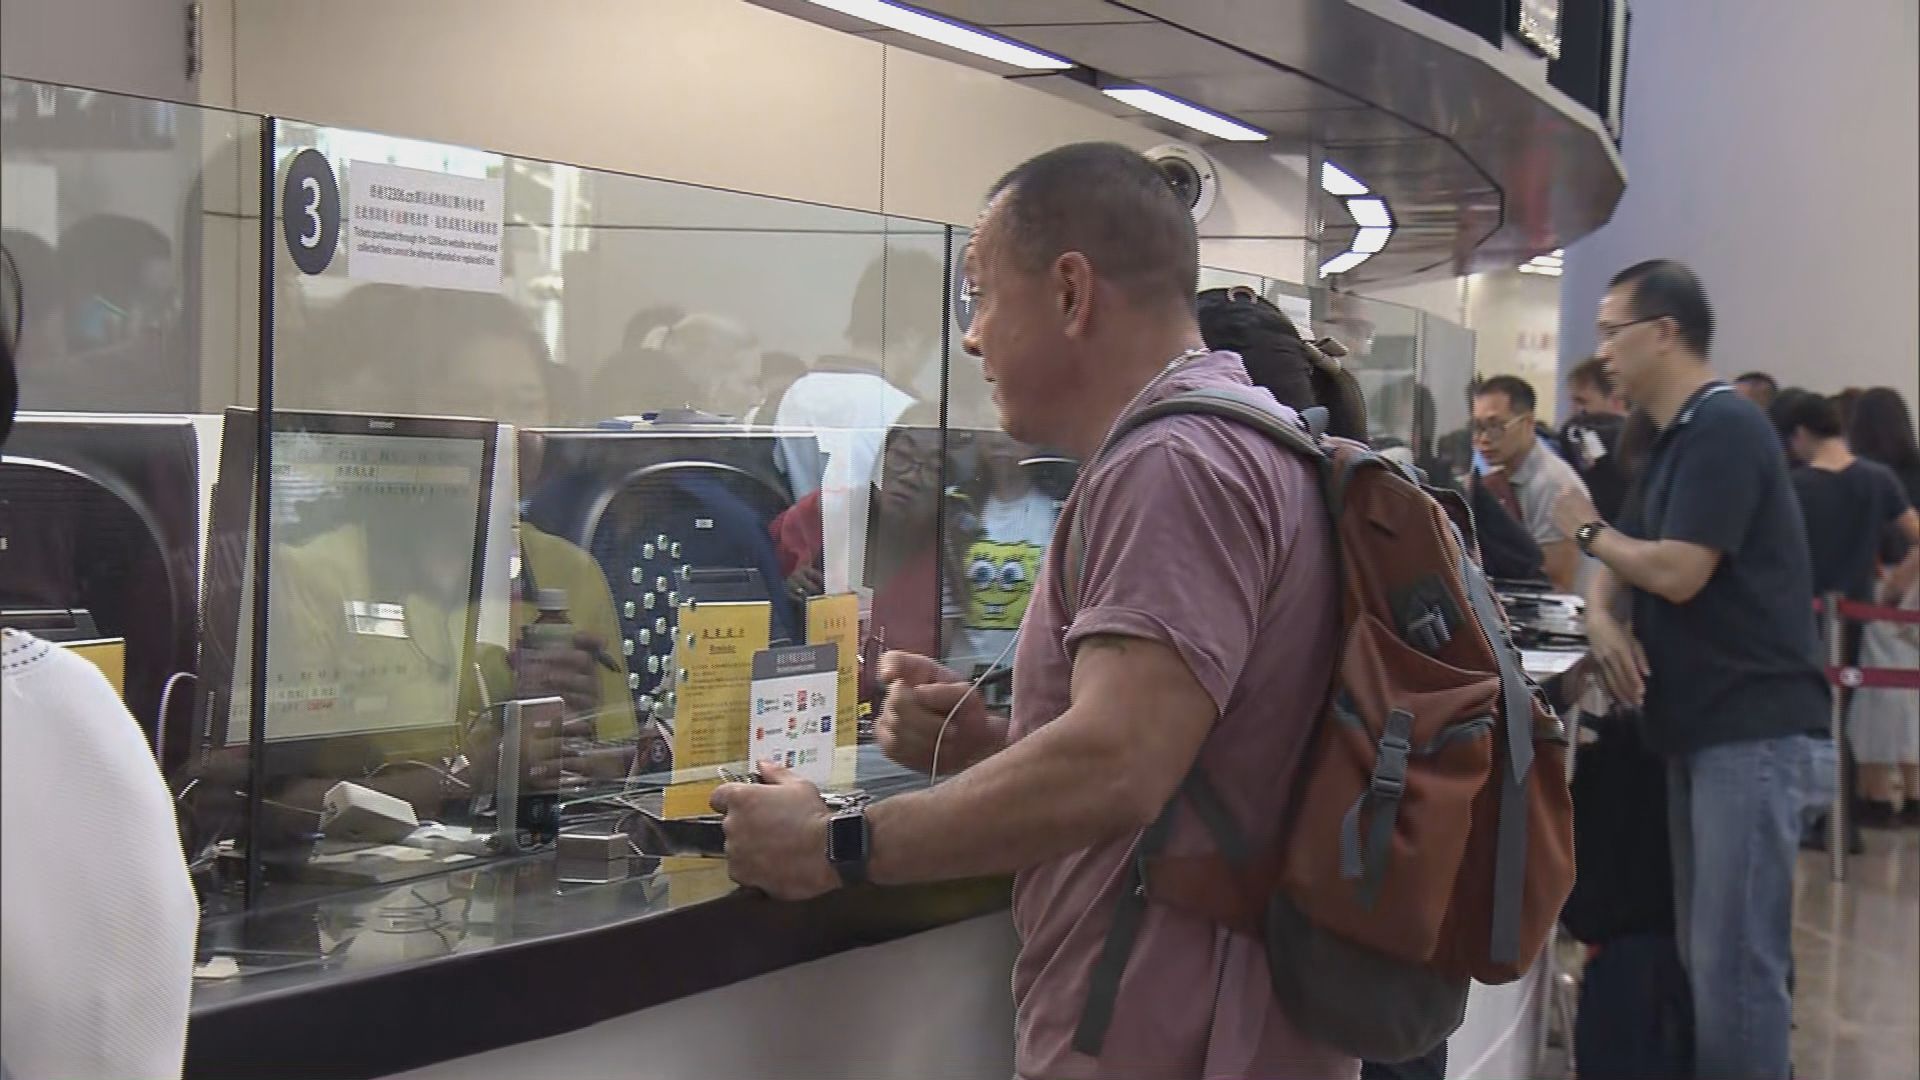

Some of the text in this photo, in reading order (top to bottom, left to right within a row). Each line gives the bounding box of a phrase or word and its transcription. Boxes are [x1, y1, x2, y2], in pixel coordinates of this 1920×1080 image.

[300, 176, 321, 249] 3
[354, 226, 372, 238] Tickets
[372, 229, 398, 242] purchased
[398, 231, 418, 245] through
[418, 235, 426, 244] the
[448, 238, 466, 249] website
[473, 240, 488, 251] hotline
[489, 243, 498, 253] and
[357, 242, 380, 253] collected
[381, 245, 391, 256] here
[392, 247, 409, 258] cannot
[410, 247, 416, 257] be
[435, 250, 456, 262] refunded
[462, 255, 482, 266] replaced
[960, 273, 972, 315] 4
